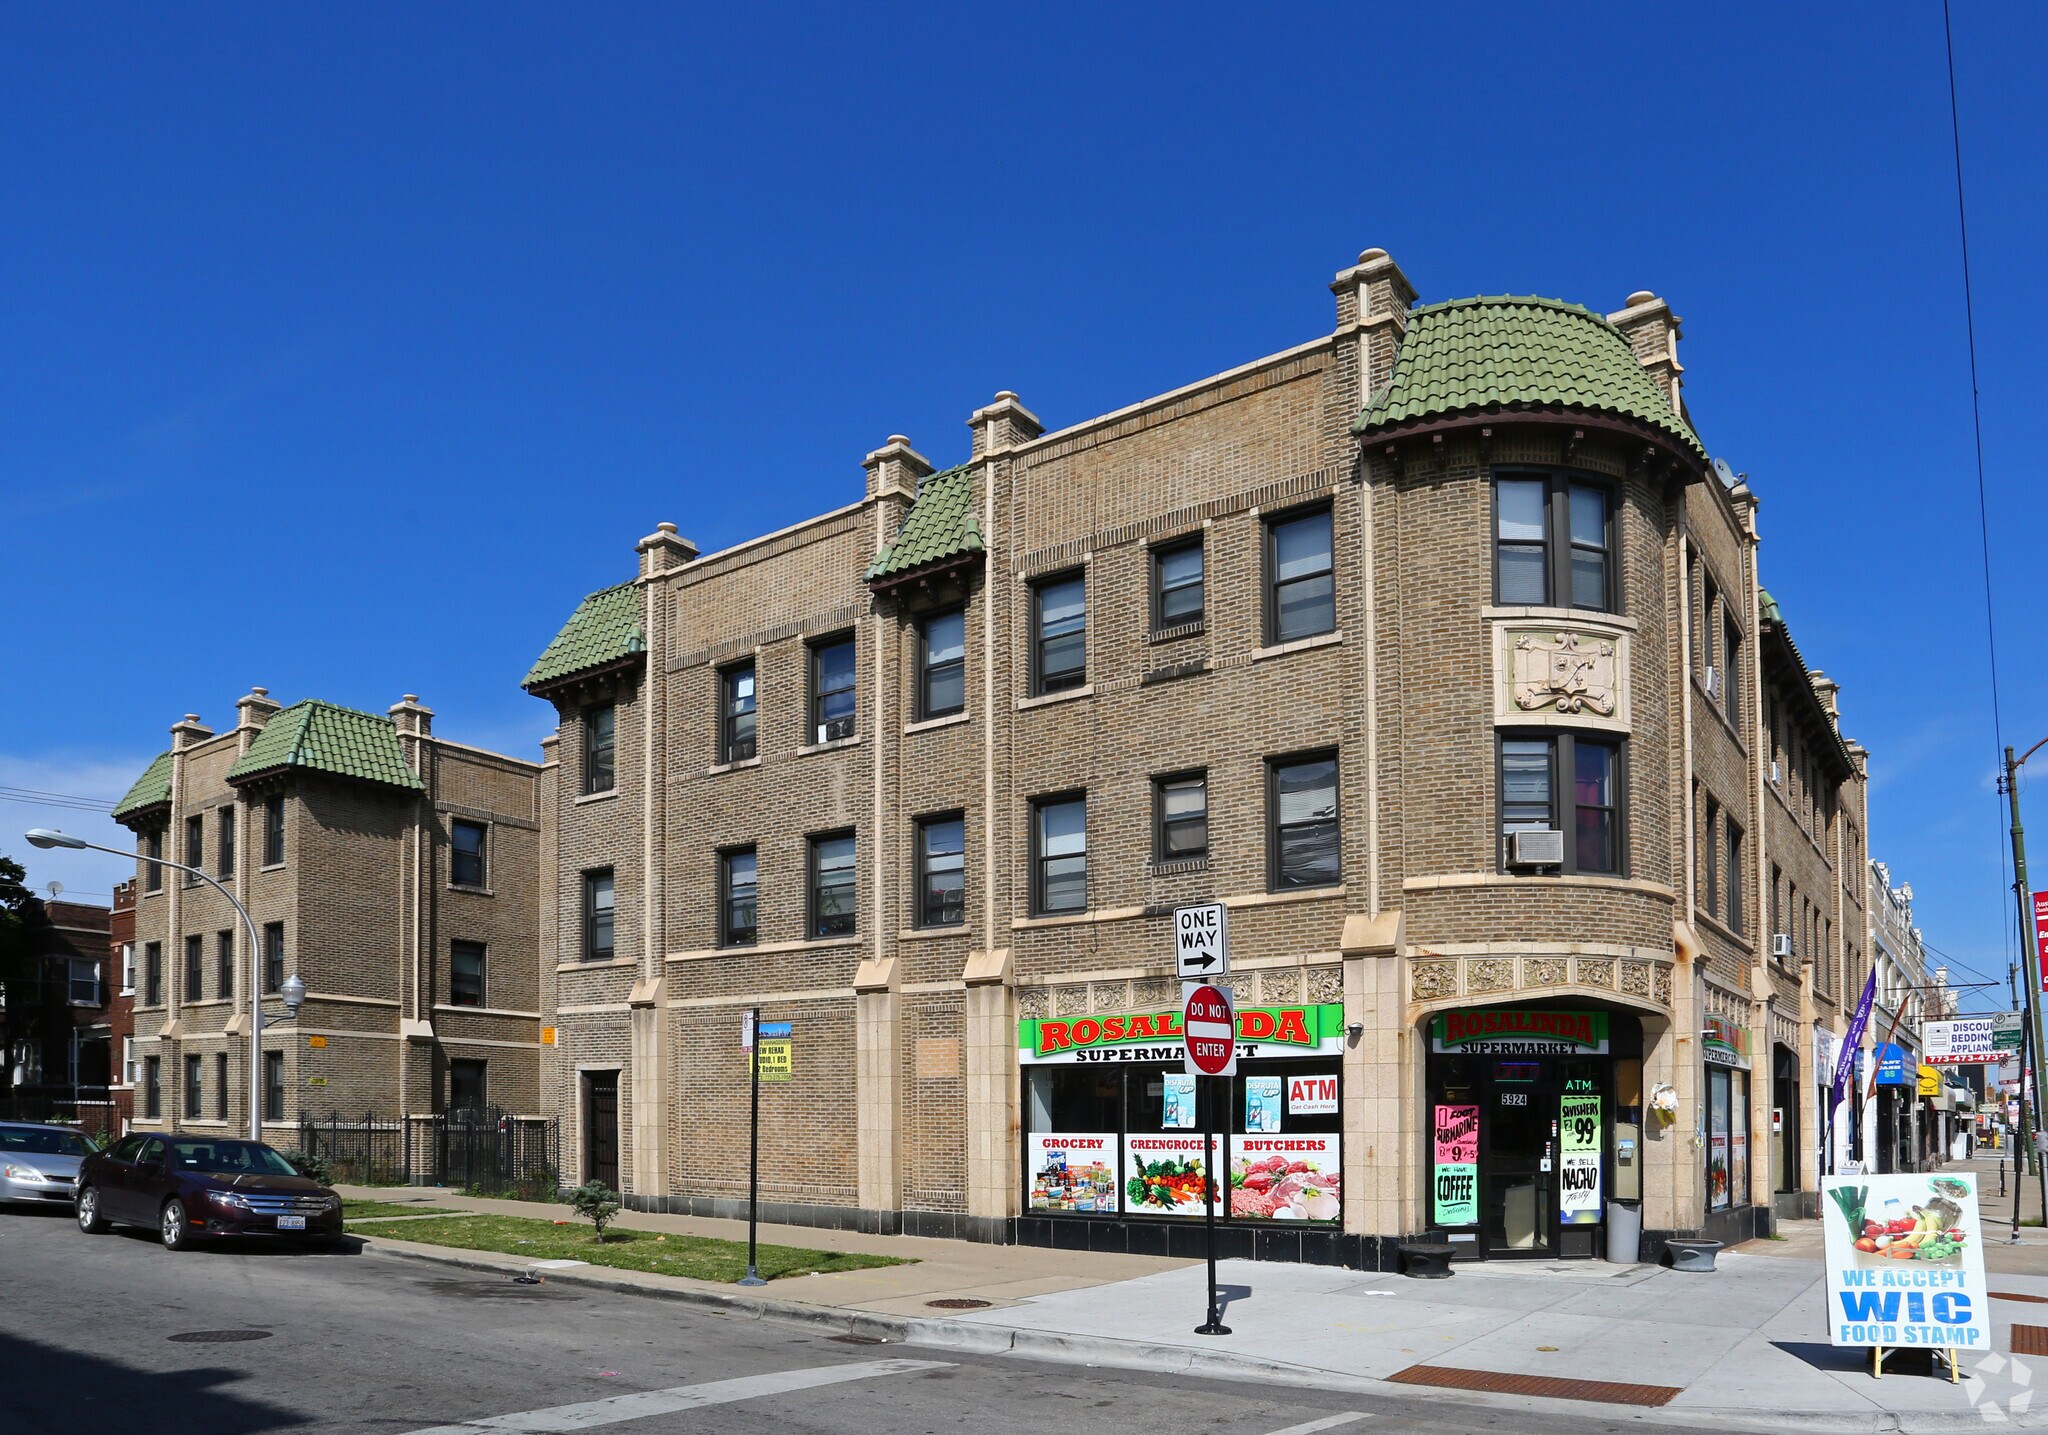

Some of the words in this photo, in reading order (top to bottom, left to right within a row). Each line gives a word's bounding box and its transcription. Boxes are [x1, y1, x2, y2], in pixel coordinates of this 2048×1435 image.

[1181, 910, 1217, 929] ONE
[1181, 930, 1217, 949] WAY
[1191, 1002, 1204, 1017] DO
[1209, 1004, 1227, 1018] NOT
[1040, 1009, 1312, 1053] ROSALDA
[1446, 1012, 1594, 1043] ROSALINDA
[1076, 1044, 1259, 1062] SUPERMAT
[1196, 1043, 1225, 1057] ENTER
[1461, 1042, 1579, 1054] SUPERMARKET
[1178, 1086, 1195, 1094] UP
[1247, 1082, 1279, 1090] DISFRUTA
[1290, 1079, 1337, 1102] ATM
[1566, 1080, 1592, 1091] ATM
[1262, 1089, 1280, 1098] UP
[1502, 1094, 1526, 1105] 5924
[1450, 1107, 1476, 1119] FOOT
[1562, 1103, 1599, 1118] SWISHERS
[1437, 1116, 1478, 1144] SUBMARINE
[1042, 1138, 1104, 1149] GROCERY
[1130, 1139, 1218, 1151] GREENGROCES
[1243, 1140, 1326, 1151] BUTCHERS
[1567, 1158, 1576, 1166] WE
[1578, 1158, 1595, 1166] SELL
[1562, 1167, 1597, 1190] NACHO
[1437, 1175, 1473, 1201] COFFEE
[1842, 1270, 1876, 1287] WE
[1882, 1270, 1967, 1288] ACCEPT
[1839, 1291, 1972, 1324] WIC
[1841, 1325, 1897, 1342] FOOD
[1904, 1326, 1980, 1345] STAMP
